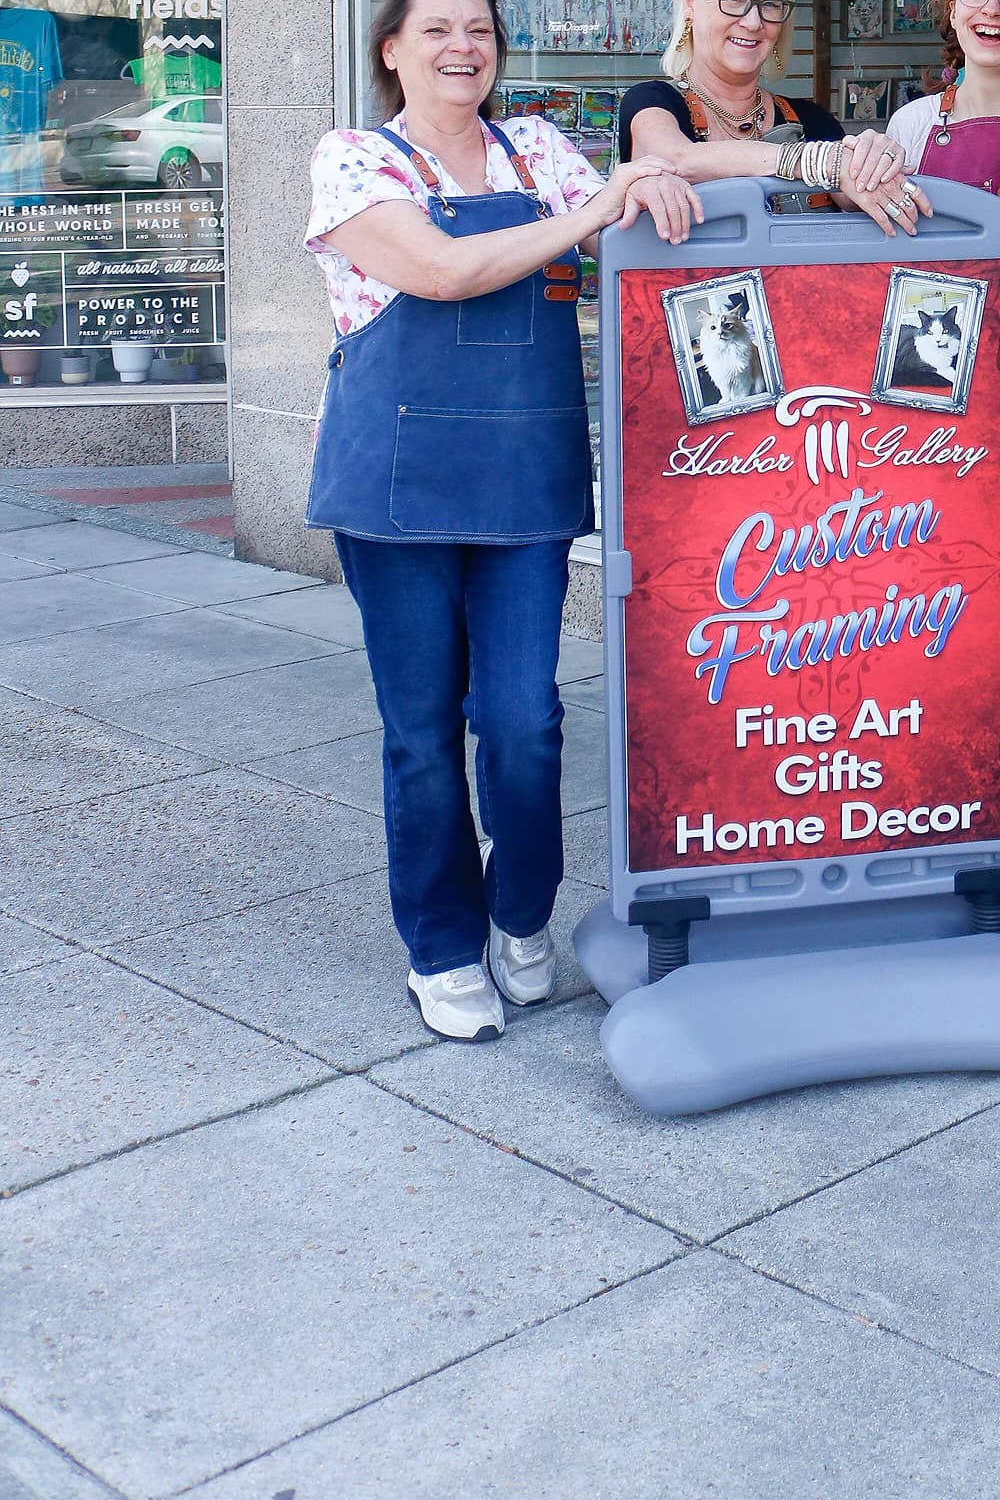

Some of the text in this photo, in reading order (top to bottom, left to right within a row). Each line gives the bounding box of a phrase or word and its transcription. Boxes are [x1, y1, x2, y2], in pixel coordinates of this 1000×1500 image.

[22, 205, 56, 216] BEST
[63, 204, 78, 215] IN
[84, 204, 112, 214] THE
[136, 202, 182, 214] FRESH
[54, 220, 112, 231] WORLD
[136, 218, 180, 230] MADE
[77, 261, 100, 275] all
[102, 260, 160, 275] natural,
[164, 259, 187, 273] all
[5, 292, 37, 320] sf
[78, 297, 198, 310] POWER TO THE
[79, 313, 199, 326] PRODUCE
[662, 425, 989, 477] Harbor Gallery
[715, 487, 941, 609] Custom
[686, 583, 969, 704] Framing
[735, 699, 924, 748] Fine Art
[774, 749, 883, 795] Gifts
[676, 800, 982, 854] Home Decor
